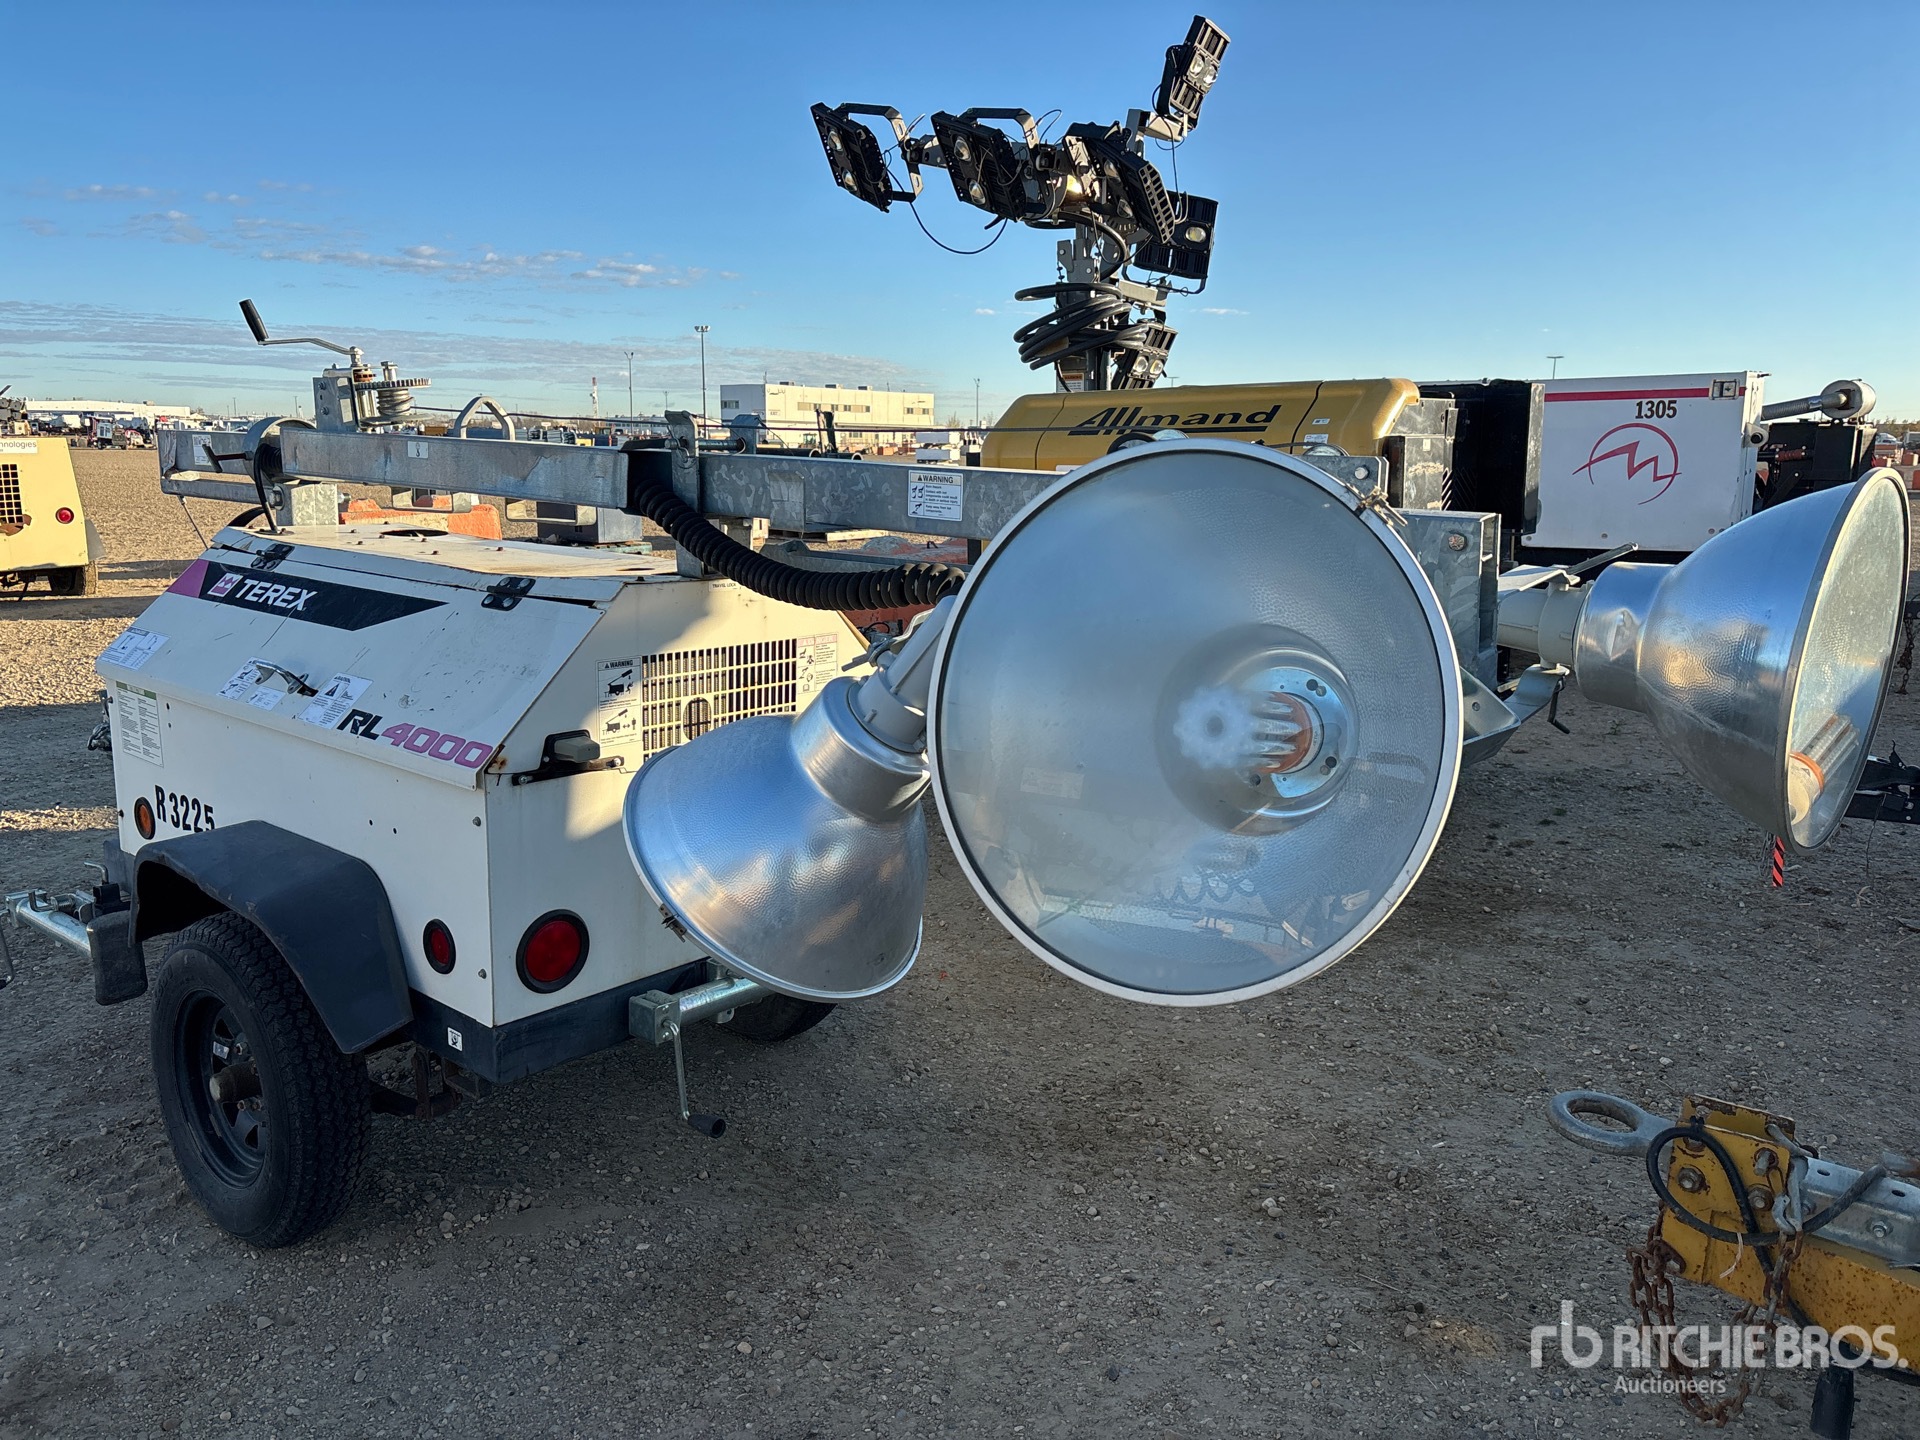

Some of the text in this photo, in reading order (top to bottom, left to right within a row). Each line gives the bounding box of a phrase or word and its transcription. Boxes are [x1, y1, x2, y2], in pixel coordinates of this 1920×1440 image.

[1067, 404, 1282, 436] Allmand
[1635, 399, 1678, 420] 1305
[922, 474, 954, 484] WARNING
[235, 579, 318, 611] TEREX
[610, 659, 633, 669] WARNING
[154, 784, 215, 833] R 3225
